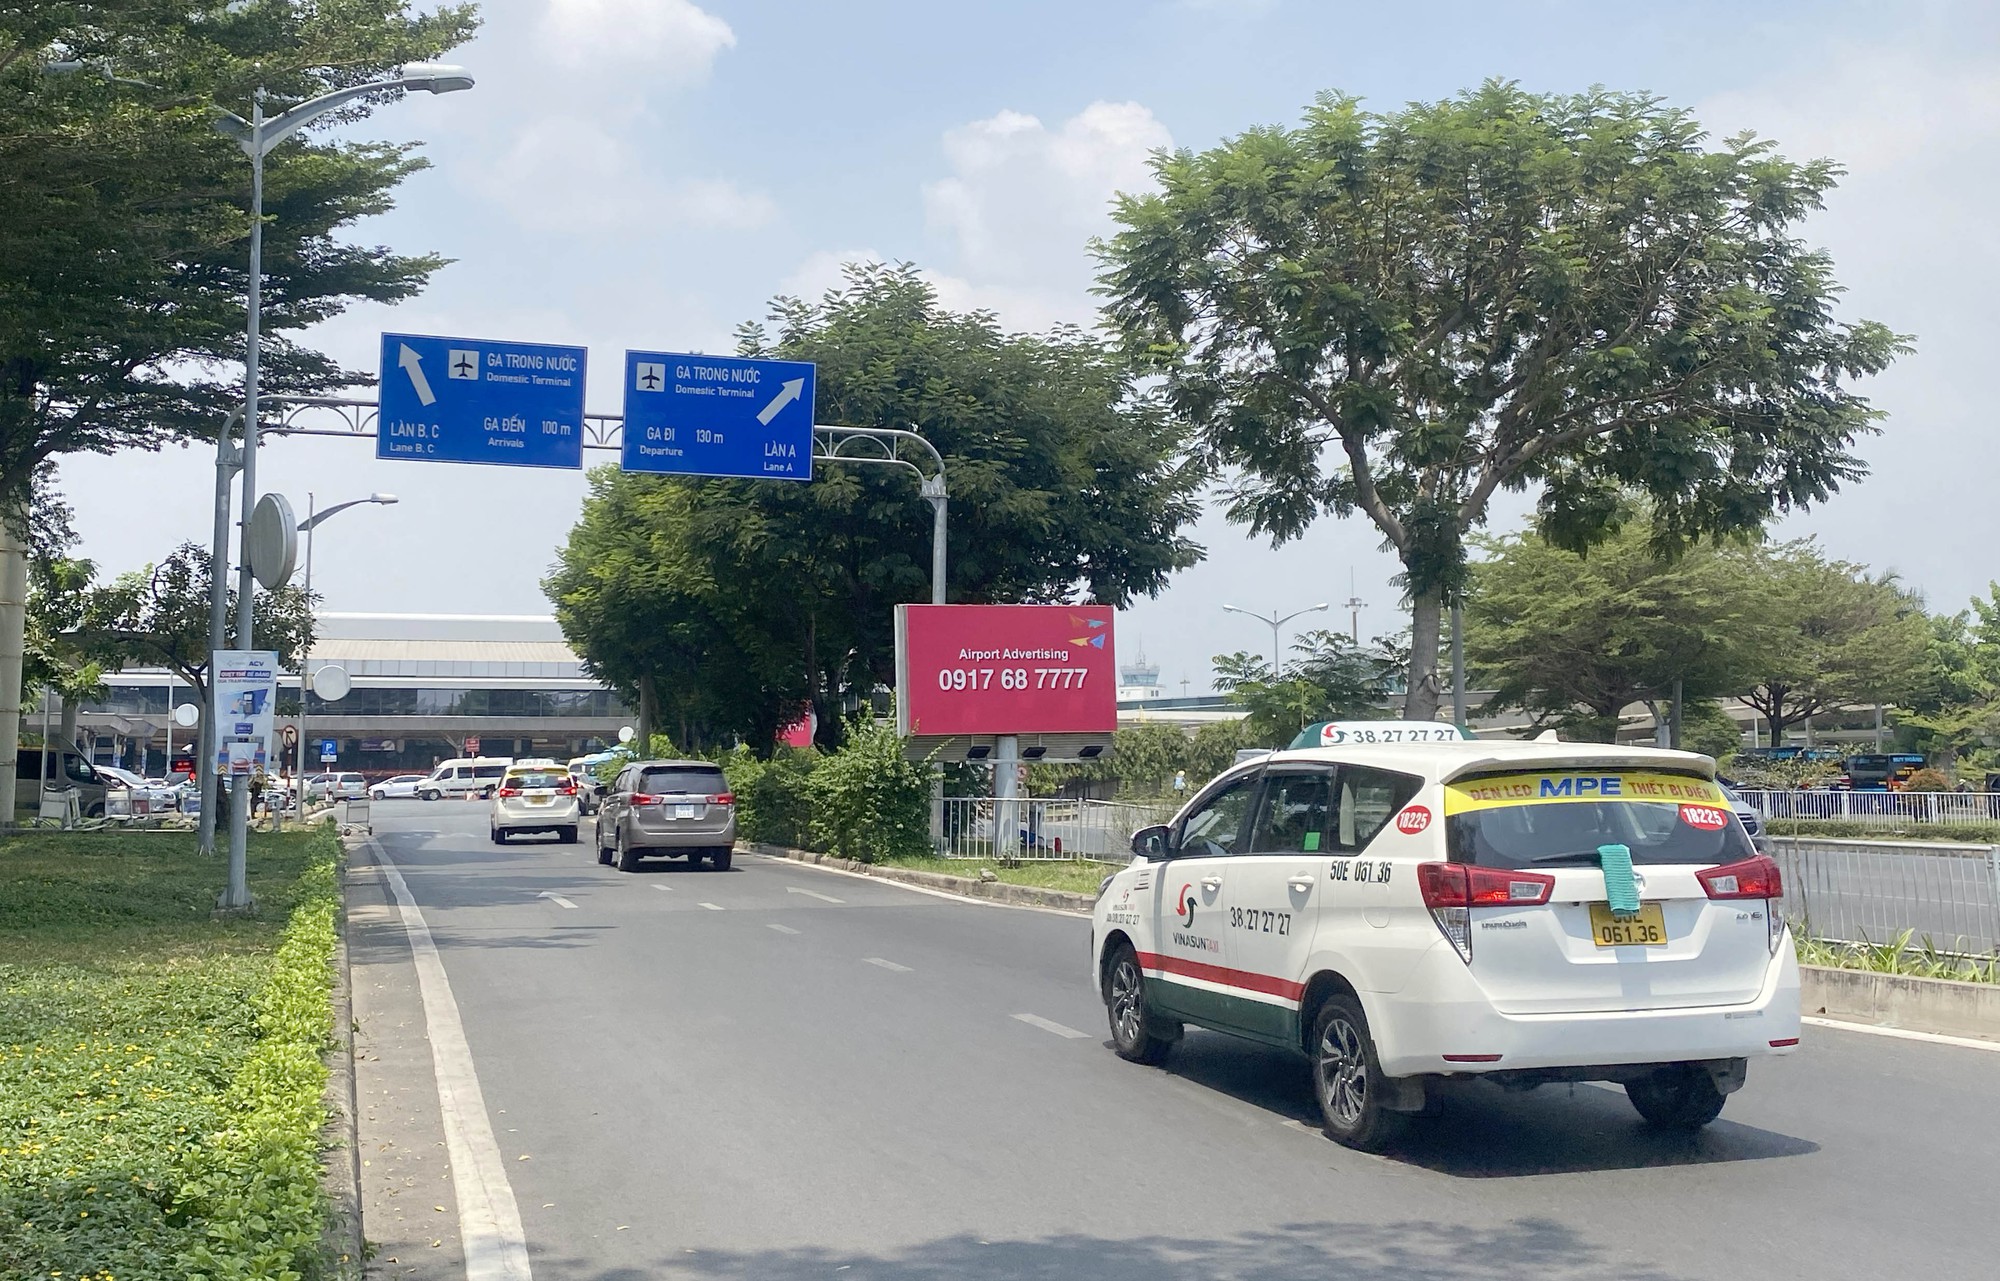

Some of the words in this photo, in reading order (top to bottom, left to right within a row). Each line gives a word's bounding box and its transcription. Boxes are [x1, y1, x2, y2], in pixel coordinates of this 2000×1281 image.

[487, 352, 503, 367] GA
[505, 354, 543, 370] TRONG
[546, 354, 577, 372] NƯỚC
[486, 372, 530, 384] Domestic
[531, 374, 571, 387] Terminal
[676, 365, 691, 379] GA
[693, 366, 729, 382] TRONG
[731, 366, 761, 384] NƯỚC
[675, 384, 716, 396] Domestic
[717, 386, 755, 398] Terminal
[390, 419, 415, 437] LÀN
[431, 424, 440, 439] C
[483, 417, 500, 431] GA
[501, 413, 526, 433] ĐẾN
[542, 420, 558, 435] 100
[560, 424, 571, 436] m
[487, 437, 525, 449] Arrivals
[646, 426, 662, 440] GA
[663, 427, 676, 442] ĐI
[696, 429, 712, 443] 130
[713, 433, 724, 444] m
[390, 442, 413, 452] Lane
[427, 443, 435, 454] C
[639, 445, 684, 457] Departure
[764, 440, 787, 457] LÀN
[788, 444, 797, 458] A
[763, 461, 785, 472] Lane
[785, 462, 794, 473] A
[959, 648, 1000, 662] Airport
[1003, 648, 1069, 662] Advertising
[939, 669, 994, 691] 0917
[1001, 668, 1028, 690] 68
[1034, 668, 1088, 689] 7777
[1353, 730, 1402, 743] 38.27
[1408, 730, 1429, 742] 27
[1434, 729, 1455, 742] 27
[325, 743, 333, 752] P
[1503, 784, 1532, 798] LED
[1540, 777, 1622, 798] MPE
[1399, 812, 1428, 830] 18225
[1682, 808, 1723, 826] 18225
[1330, 860, 1351, 881] 50E
[1354, 861, 1373, 882] 061
[1377, 861, 1392, 883] 36
[1230, 906, 1259, 931] 38.27
[1261, 910, 1275, 933] 27
[1277, 912, 1291, 936] 27
[1602, 925, 1659, 943] 061.36
